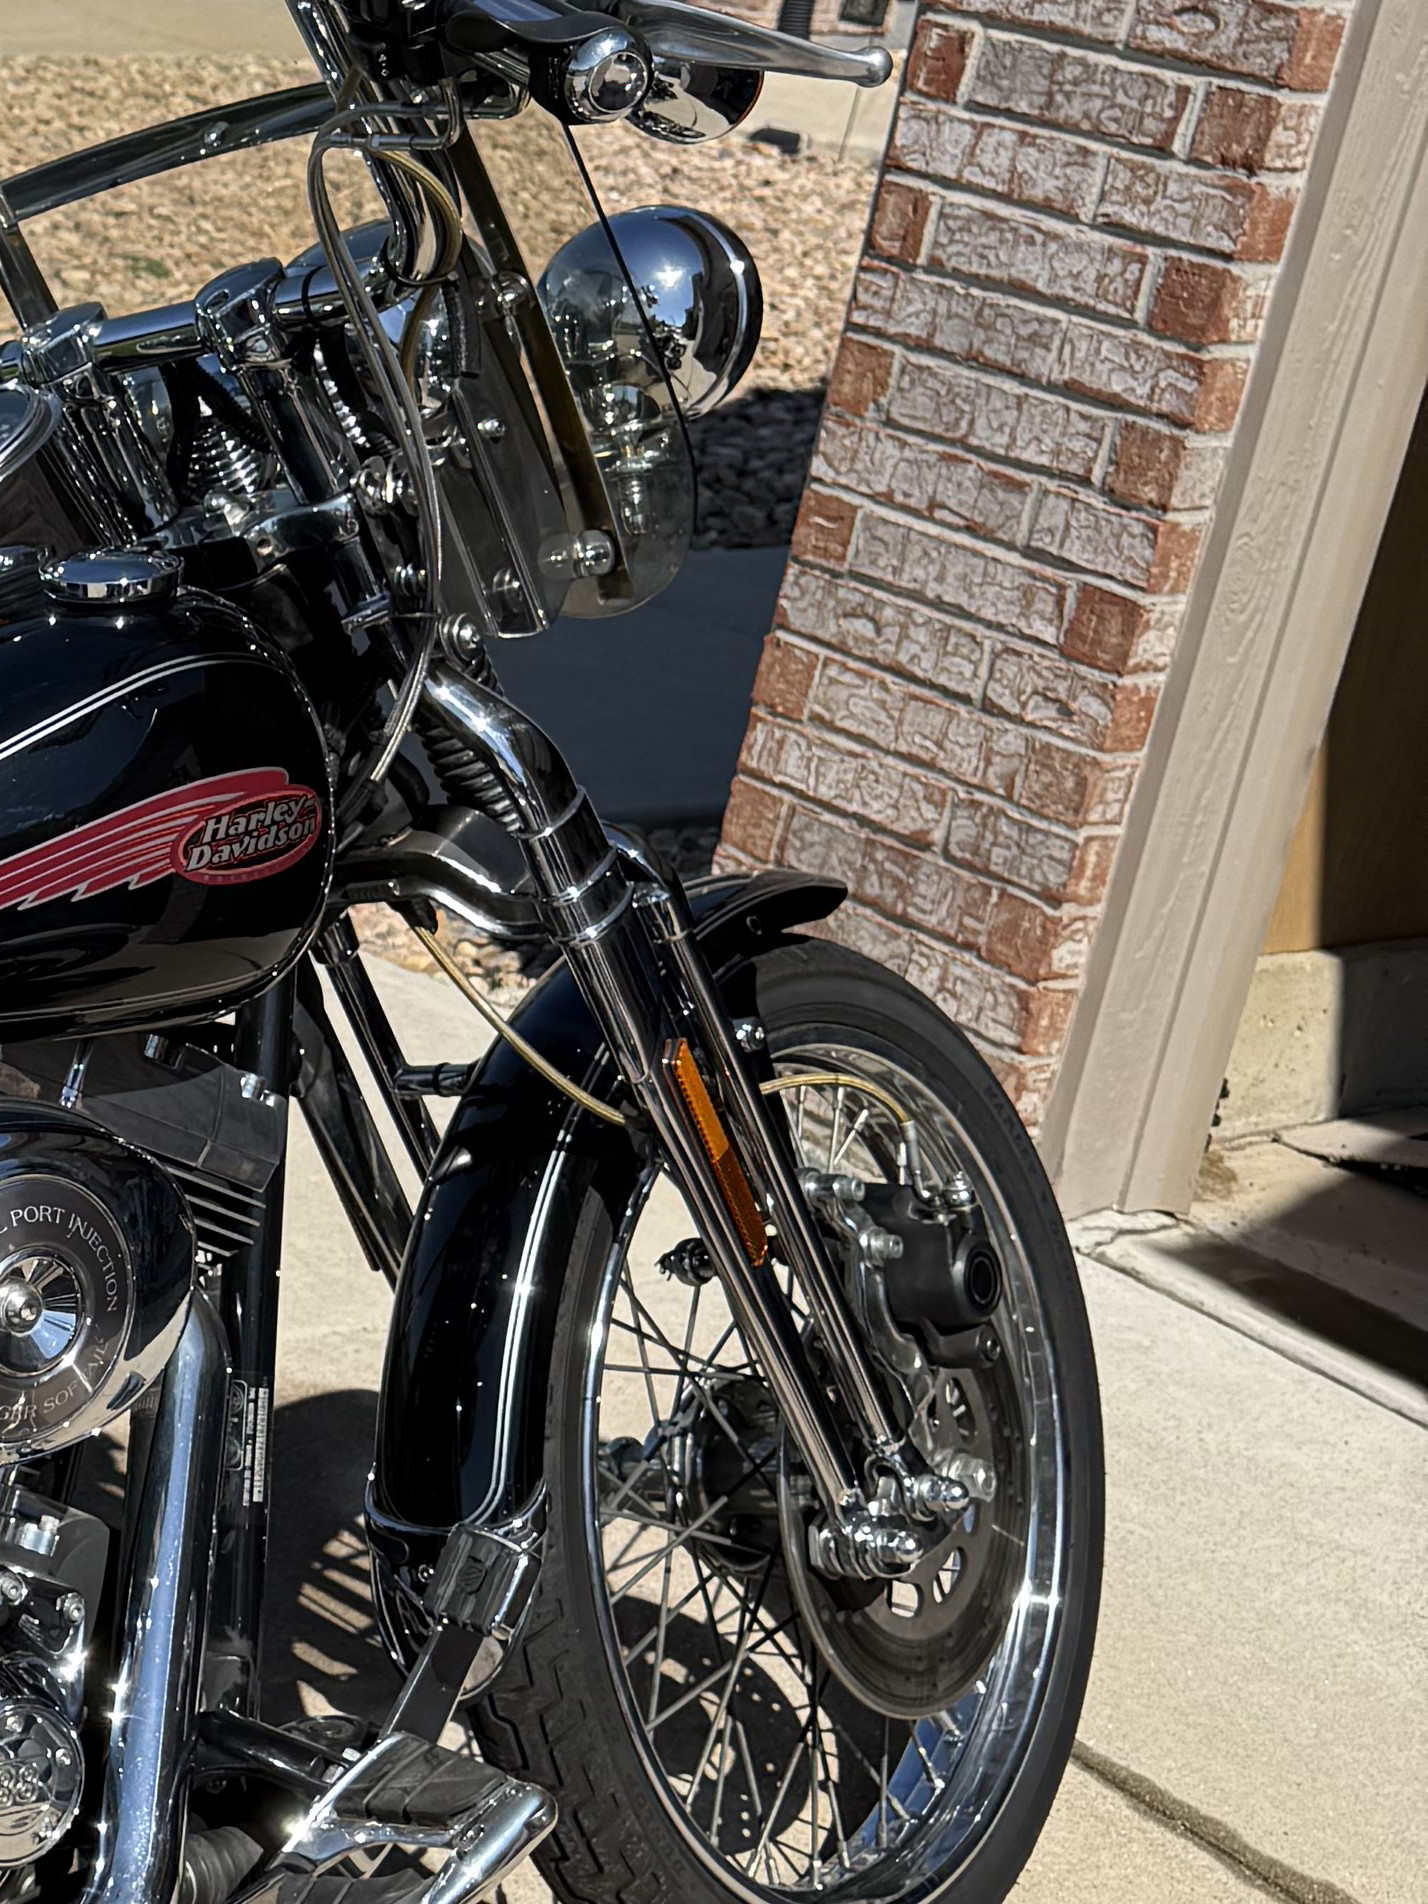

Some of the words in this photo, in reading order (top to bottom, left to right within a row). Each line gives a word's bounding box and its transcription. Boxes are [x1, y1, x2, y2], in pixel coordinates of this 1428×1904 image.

[185, 815, 315, 872] Davidson
[9, 1204, 66, 1228] PORT
[67, 1207, 120, 1313] INJECTION
